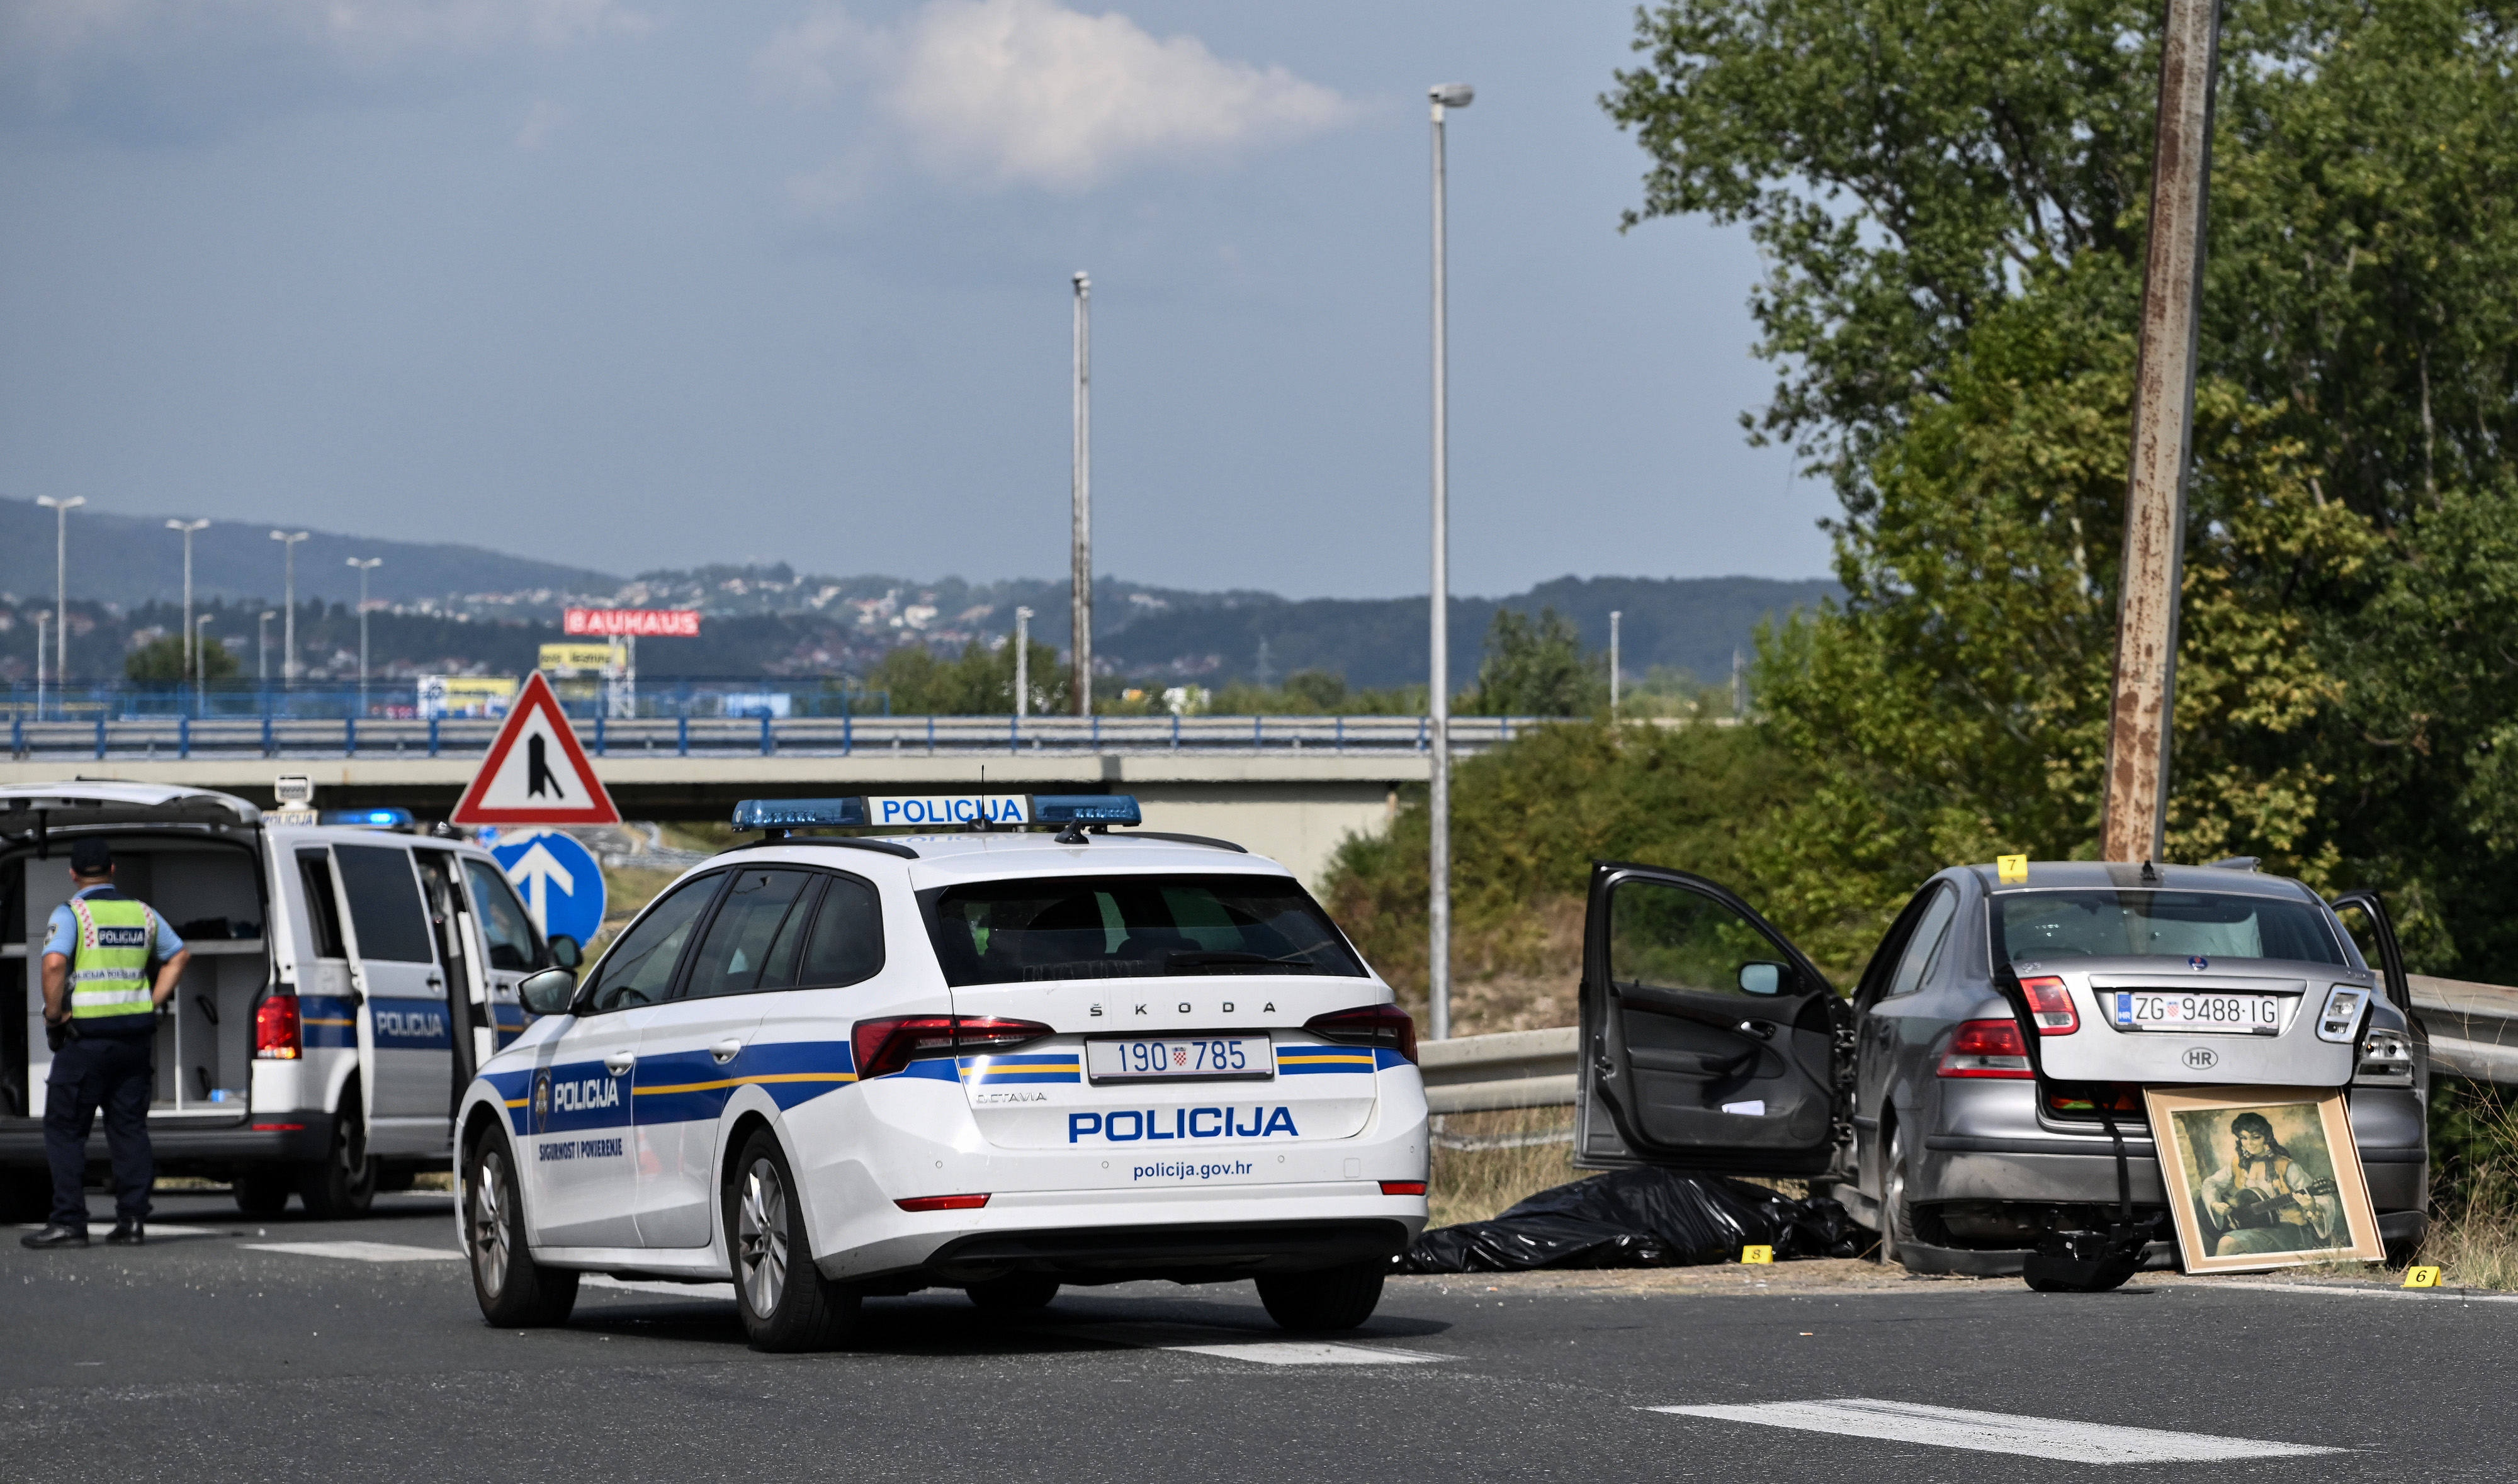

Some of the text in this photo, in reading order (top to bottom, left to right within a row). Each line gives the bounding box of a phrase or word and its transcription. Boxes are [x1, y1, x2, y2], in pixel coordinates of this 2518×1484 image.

[568, 609, 698, 634] BAUHAUS
[882, 799, 1023, 823] POLICIJA
[2007, 859, 2016, 871] 7
[99, 930, 144, 943] POLICIJA
[1090, 1001, 1277, 1017] ŠKODA
[2118, 1011, 2131, 1020] HR
[2135, 997, 2164, 1020] ZG
[376, 1010, 444, 1038] POLICIJA
[1118, 1040, 1246, 1072] 190 785
[2189, 1052, 2212, 1065] HR
[554, 1077, 619, 1113] POLICIJA
[976, 1092, 1047, 1104] OCTAVIA
[1068, 1106, 1299, 1144] POLICIJA
[539, 1141, 575, 1162] SIGURNOST
[576, 1141, 580, 1159] I
[1133, 1161, 1253, 1181] policija.gov.hr
[2415, 1269, 2428, 1283] 6
